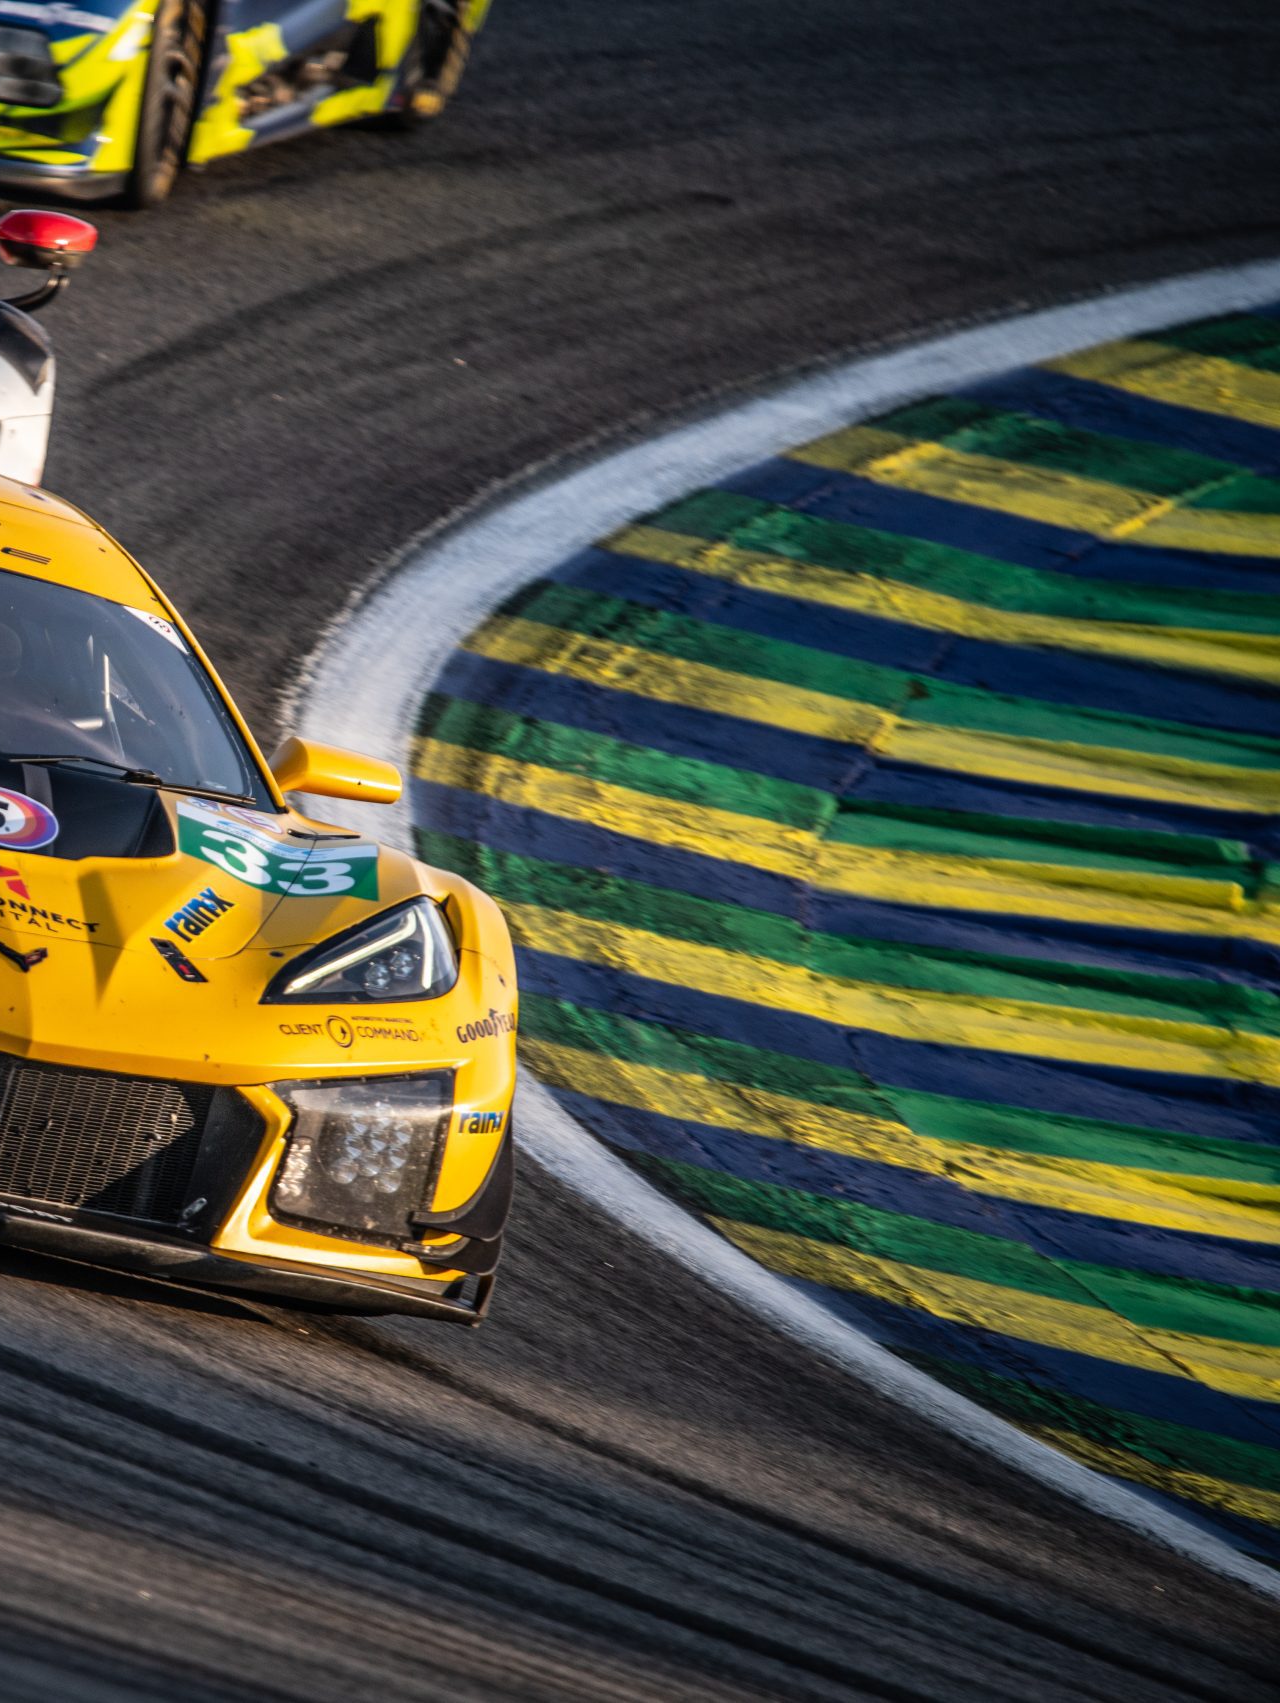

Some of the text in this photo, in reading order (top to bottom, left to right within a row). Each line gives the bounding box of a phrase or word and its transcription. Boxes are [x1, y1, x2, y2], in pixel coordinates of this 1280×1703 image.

[200, 829, 356, 895] 33
[279, 1023, 420, 1042] CLIENT COMMAND
